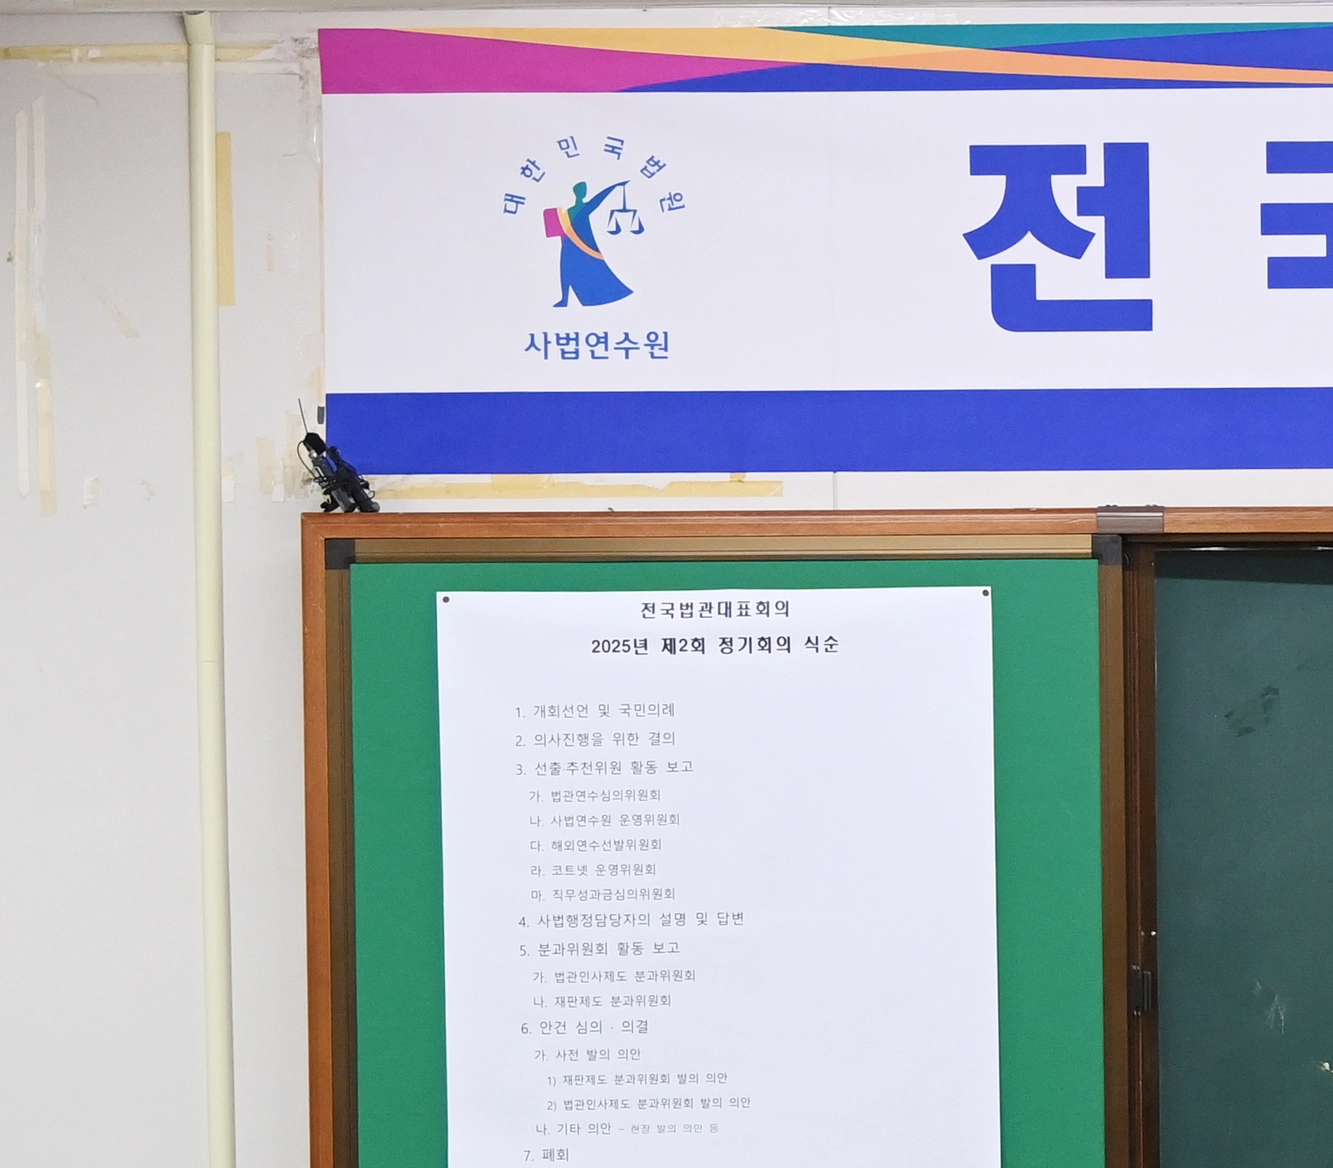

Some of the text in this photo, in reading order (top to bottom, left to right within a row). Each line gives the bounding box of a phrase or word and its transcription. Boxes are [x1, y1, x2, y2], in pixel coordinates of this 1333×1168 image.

[503, 135, 686, 215] 대한민국법원
[524, 330, 669, 361] 사법연수원
[640, 600, 790, 620] 전국법관대표회의
[591, 635, 839, 656] 2025년 제2회 정기회의 식순
[515, 702, 675, 720] 1. 개회선언 및 국민의례
[514, 730, 676, 748] 2. 의사진행을 위한 결의
[515, 759, 694, 777] 3. 선출·추천위원 활동 보고
[529, 788, 661, 804] 가. 법관연수심의위원회
[529, 813, 680, 829] 나. 사법연수원 운영위원회
[529, 838, 662, 853] 다. 해외연수선발위원회
[530, 862, 657, 878] 라. 코트넷 운영위원회
[530, 887, 676, 903] 마. 직무성과금심의위원회
[517, 911, 744, 929] 4. 사법행정담당자의 설명 및 답변
[519, 941, 681, 958] 5. 분과위원회 활동 보고
[532, 968, 696, 985] 가. 법관인사제도 분과위원회
[532, 993, 672, 1009] 나. 재판제도 분과위원회
[520, 1019, 649, 1036] 6. 안건 심의 의결
[534, 1047, 642, 1062] 가. 사전 발의 의안
[547, 1072, 728, 1088] 1) 재판제도 분과위원회 발의 의안
[546, 1096, 751, 1113] 2) 법관인사제도 분과위원회 발의 의안
[535, 1121, 612, 1137] 나. 기타 의안
[523, 1147, 570, 1163] 7. 폐회
